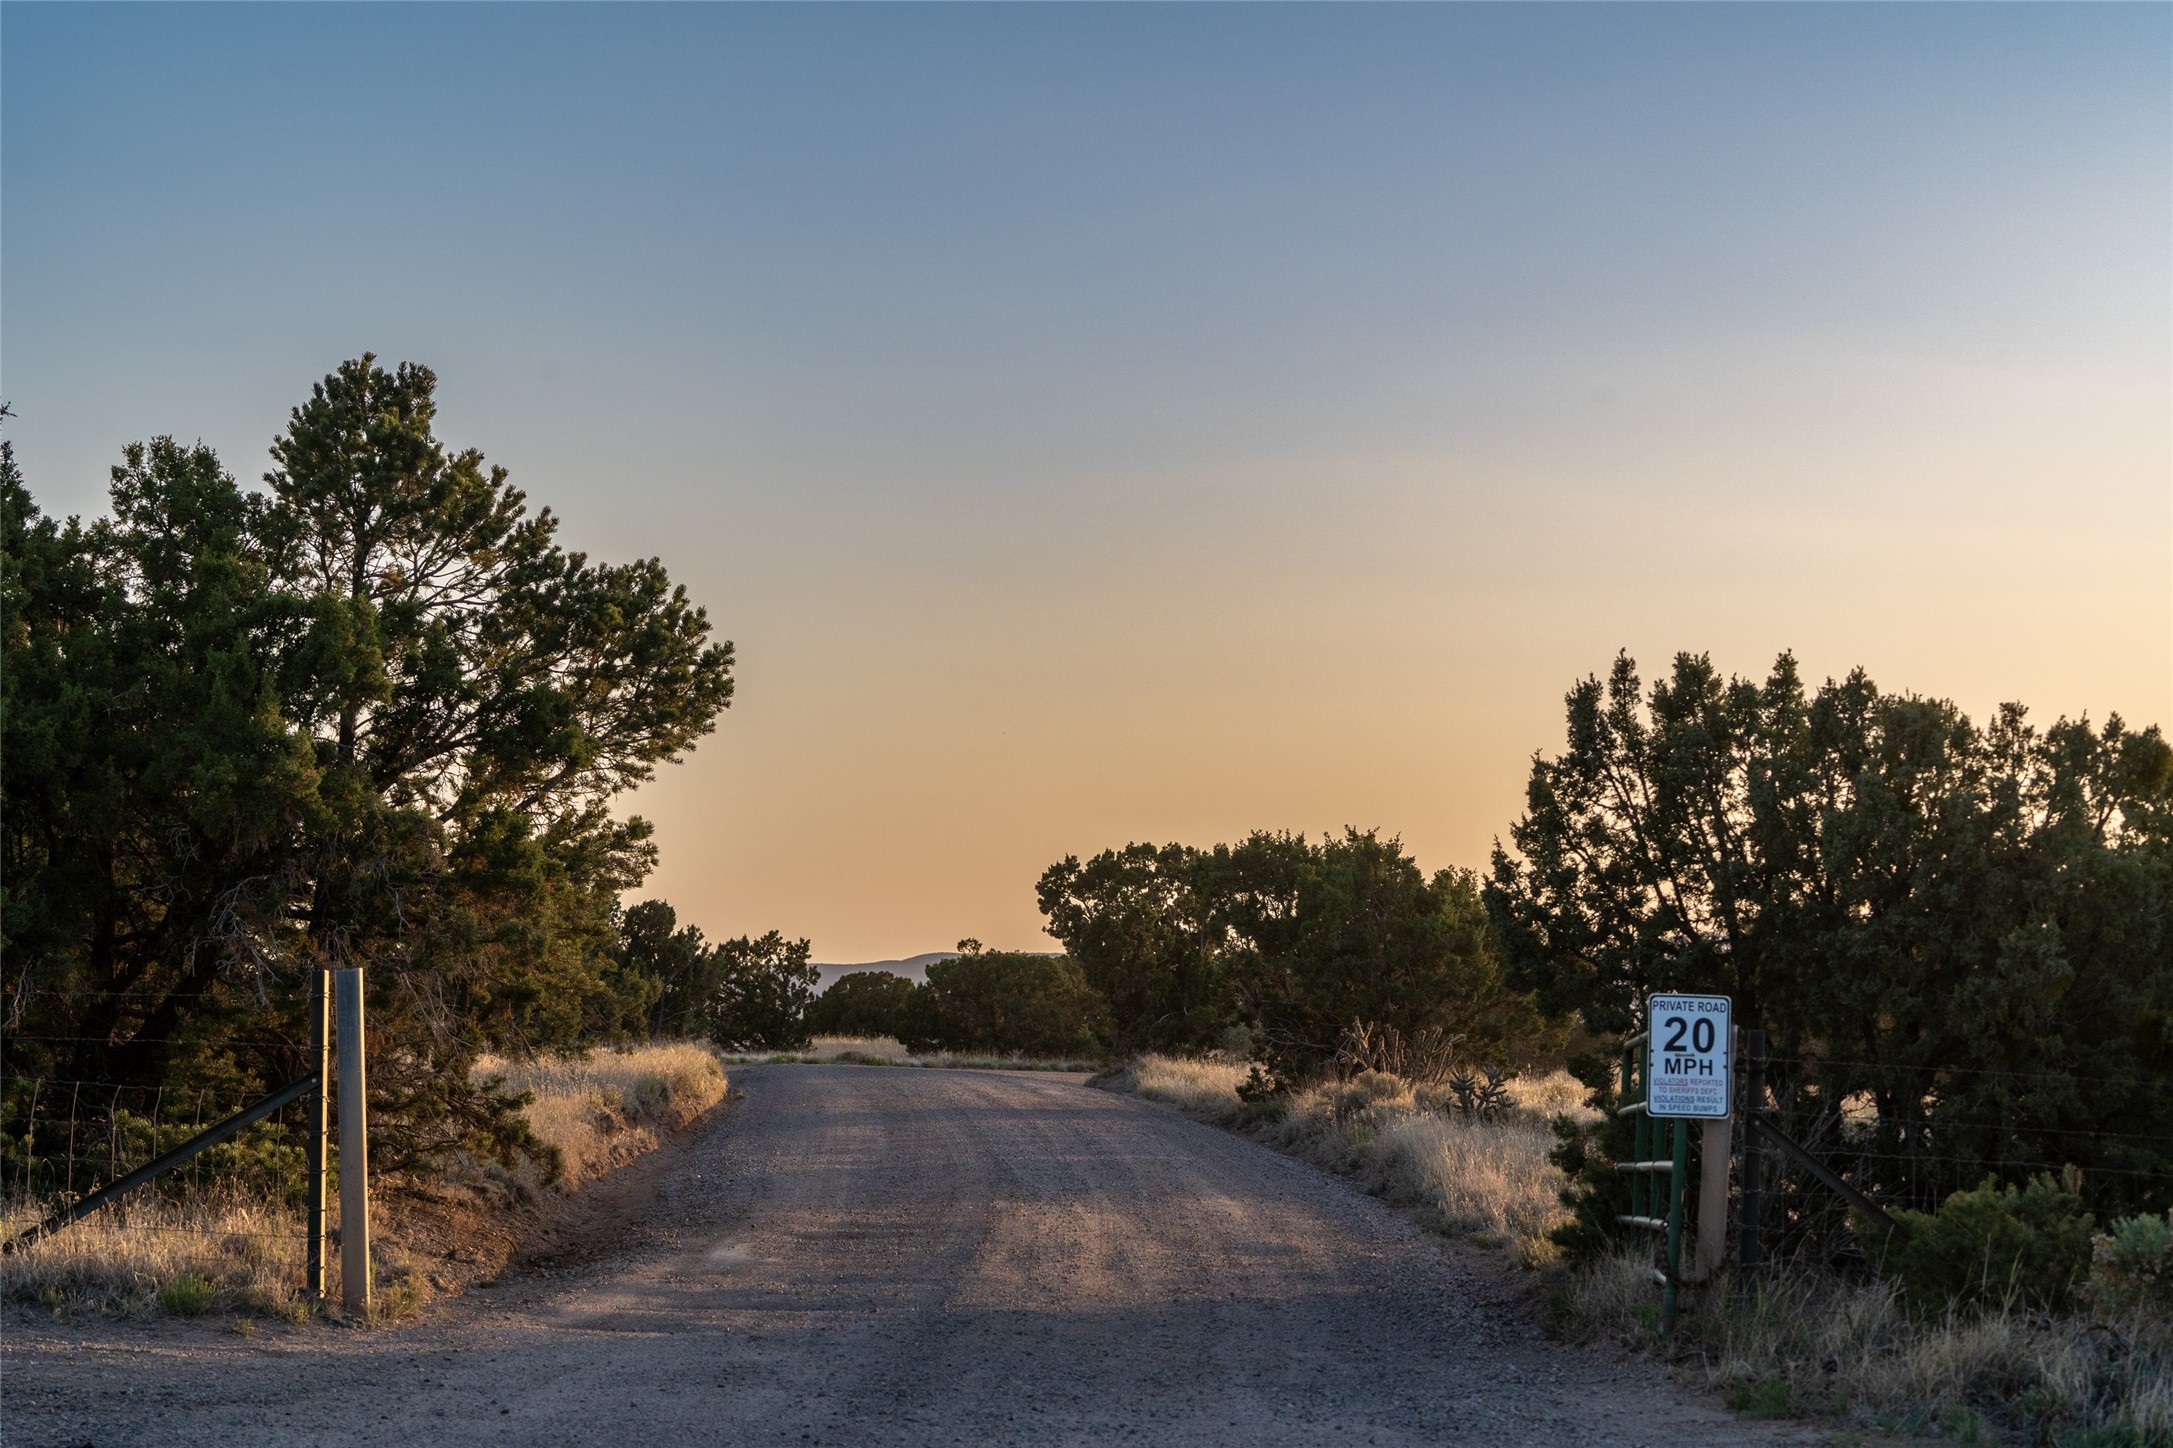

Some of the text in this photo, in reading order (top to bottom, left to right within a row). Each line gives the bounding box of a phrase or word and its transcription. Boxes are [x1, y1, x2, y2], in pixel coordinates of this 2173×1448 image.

[1652, 1000, 1727, 1013] PRIVATE ROAD
[1663, 1016, 1715, 1053] 20
[1664, 1058, 1713, 1076] MPH
[1653, 1078, 1723, 1087] VIOLATORS REPORTED
[1658, 1086, 1667, 1094] TO
[1653, 1095, 1723, 1104] VIOLATIONS RESULT
[1668, 1104, 1692, 1112] SPEED
